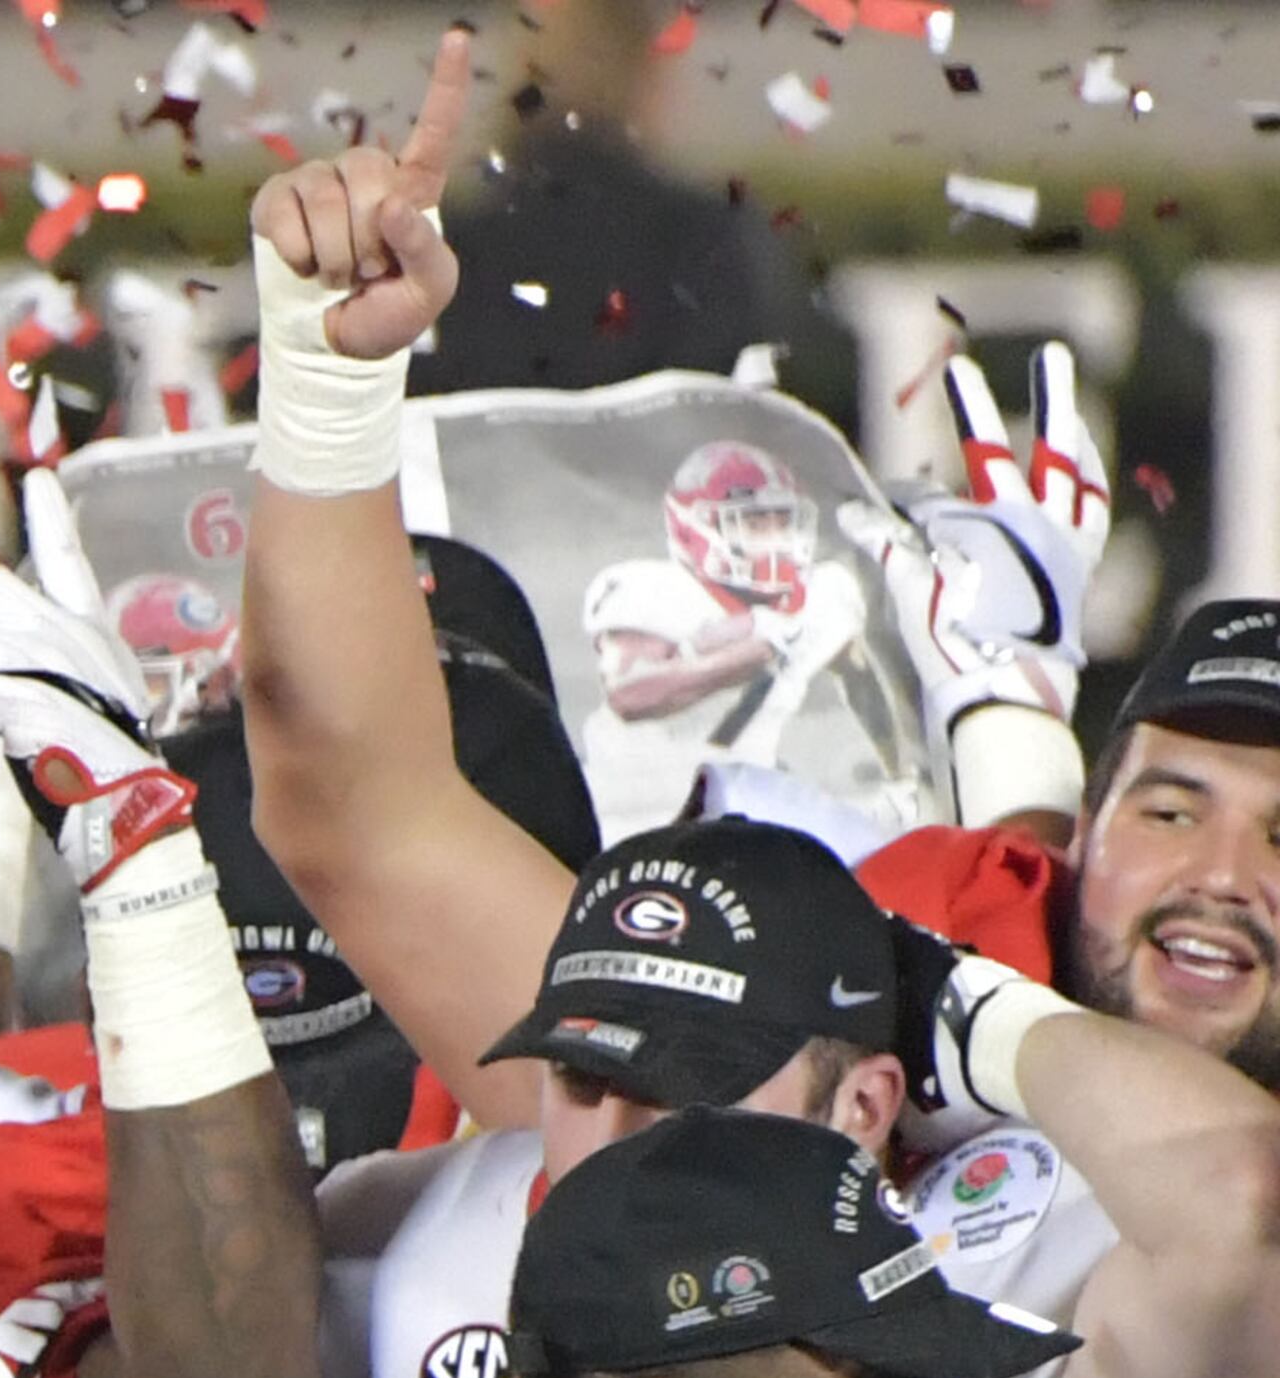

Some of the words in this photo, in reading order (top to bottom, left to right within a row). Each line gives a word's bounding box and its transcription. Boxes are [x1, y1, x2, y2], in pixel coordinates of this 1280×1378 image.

[629, 859, 696, 889] BOWL
[701, 878, 757, 943] GAME
[833, 1172, 863, 1234] ROSE
